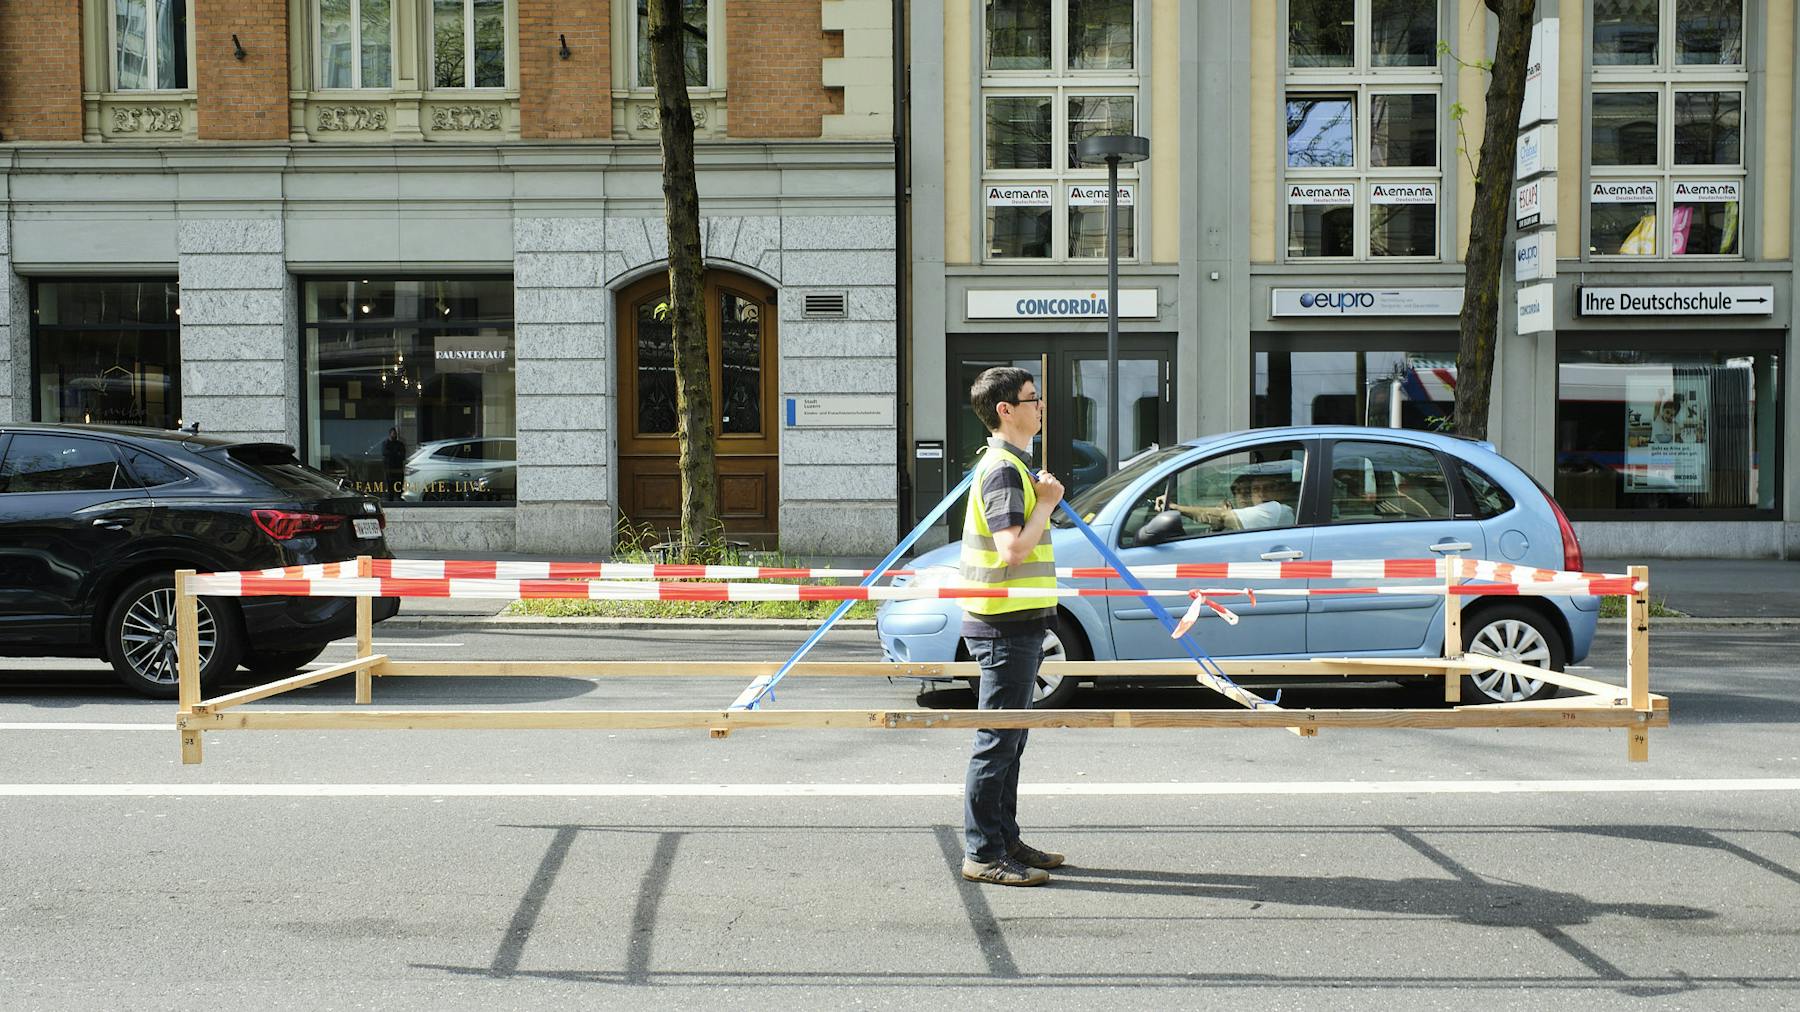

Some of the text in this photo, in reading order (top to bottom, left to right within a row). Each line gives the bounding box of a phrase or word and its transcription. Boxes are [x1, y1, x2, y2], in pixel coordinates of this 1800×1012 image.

[989, 188, 1049, 199] Alemania
[1291, 186, 1351, 197] Alemania
[1373, 186, 1433, 197] Alemania
[1593, 184, 1653, 195] Alemania
[1675, 184, 1736, 195] Alemania
[1314, 292, 1374, 312] eupro
[1585, 292, 1732, 311] Ihre Deutschschule
[435, 350, 508, 360] RAUSVERKAUF
